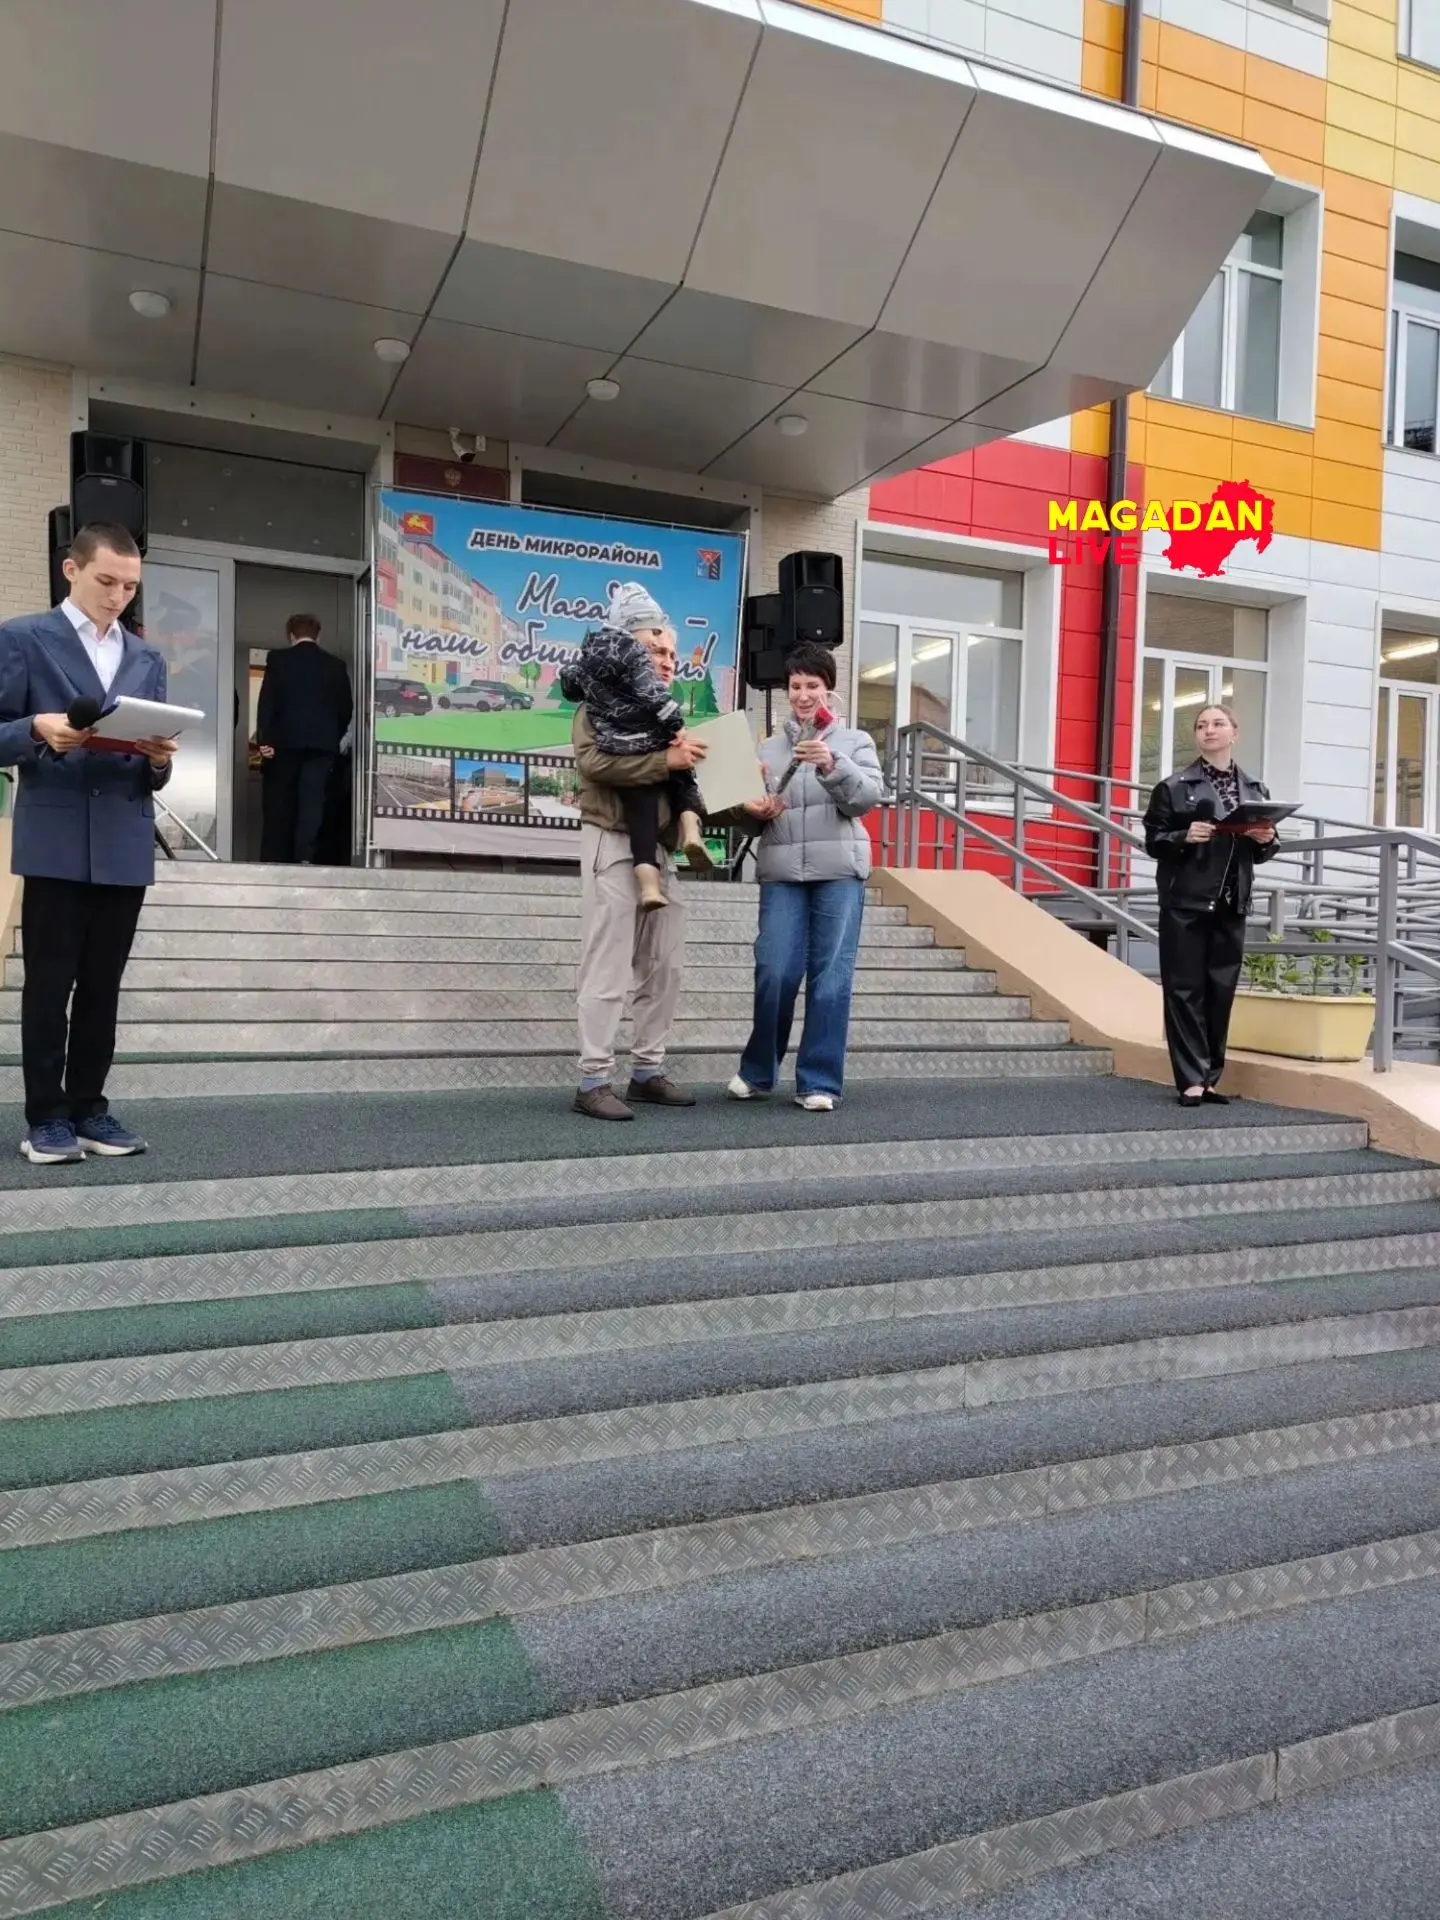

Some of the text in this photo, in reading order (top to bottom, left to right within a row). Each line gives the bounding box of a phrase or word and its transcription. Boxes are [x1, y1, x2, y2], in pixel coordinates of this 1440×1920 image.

[470, 531, 660, 568] ДЕНЬ МИКРОРАЙОНА
[401, 630, 488, 656] наш
